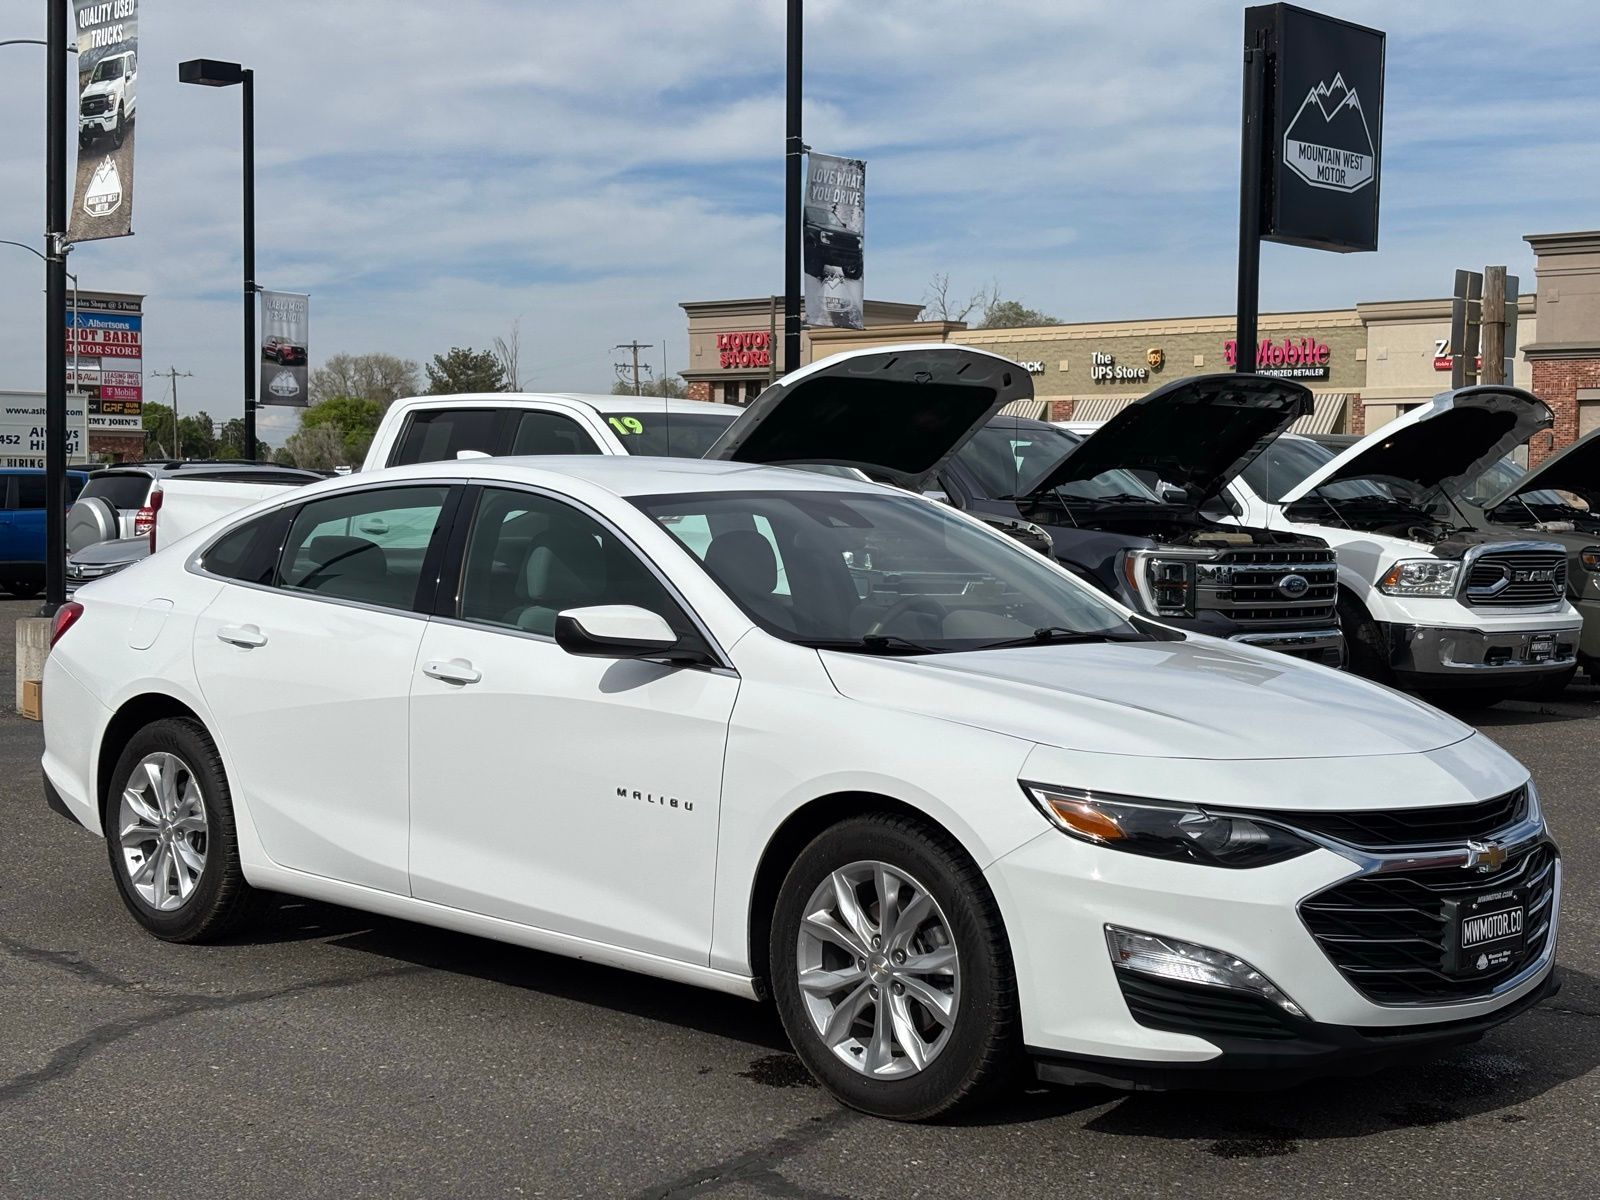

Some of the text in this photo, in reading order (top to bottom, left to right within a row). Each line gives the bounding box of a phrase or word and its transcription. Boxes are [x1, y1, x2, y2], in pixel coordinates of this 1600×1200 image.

[80, 0, 135, 28] QUALITY USED
[91, 24, 123, 48] TRUCKS
[1298, 143, 1364, 171] MOUNTAIN WEST
[812, 168, 862, 189] LOVE WHAT
[1317, 164, 1346, 184] MOTOR
[812, 186, 861, 206] YOU DRIVE
[87, 319, 130, 330] Albertsons
[102, 330, 139, 344] BARN
[66, 343, 139, 356] IQUOR STORE
[720, 350, 770, 368] STORE
[1091, 351, 1112, 365] The
[1090, 365, 1146, 380] UPS Store
[1293, 368, 1325, 377] RETAILER
[113, 387, 138, 396] Mobile
[108, 418, 138, 427] JOHN'S
[608, 416, 643, 435] 19
[29, 427, 79, 440] Alys
[7, 458, 44, 468] HIRING
[1515, 570, 1555, 581] RAM
[616, 787, 694, 811] MALIBU
[1464, 910, 1522, 944] MWMOTOR.CO
